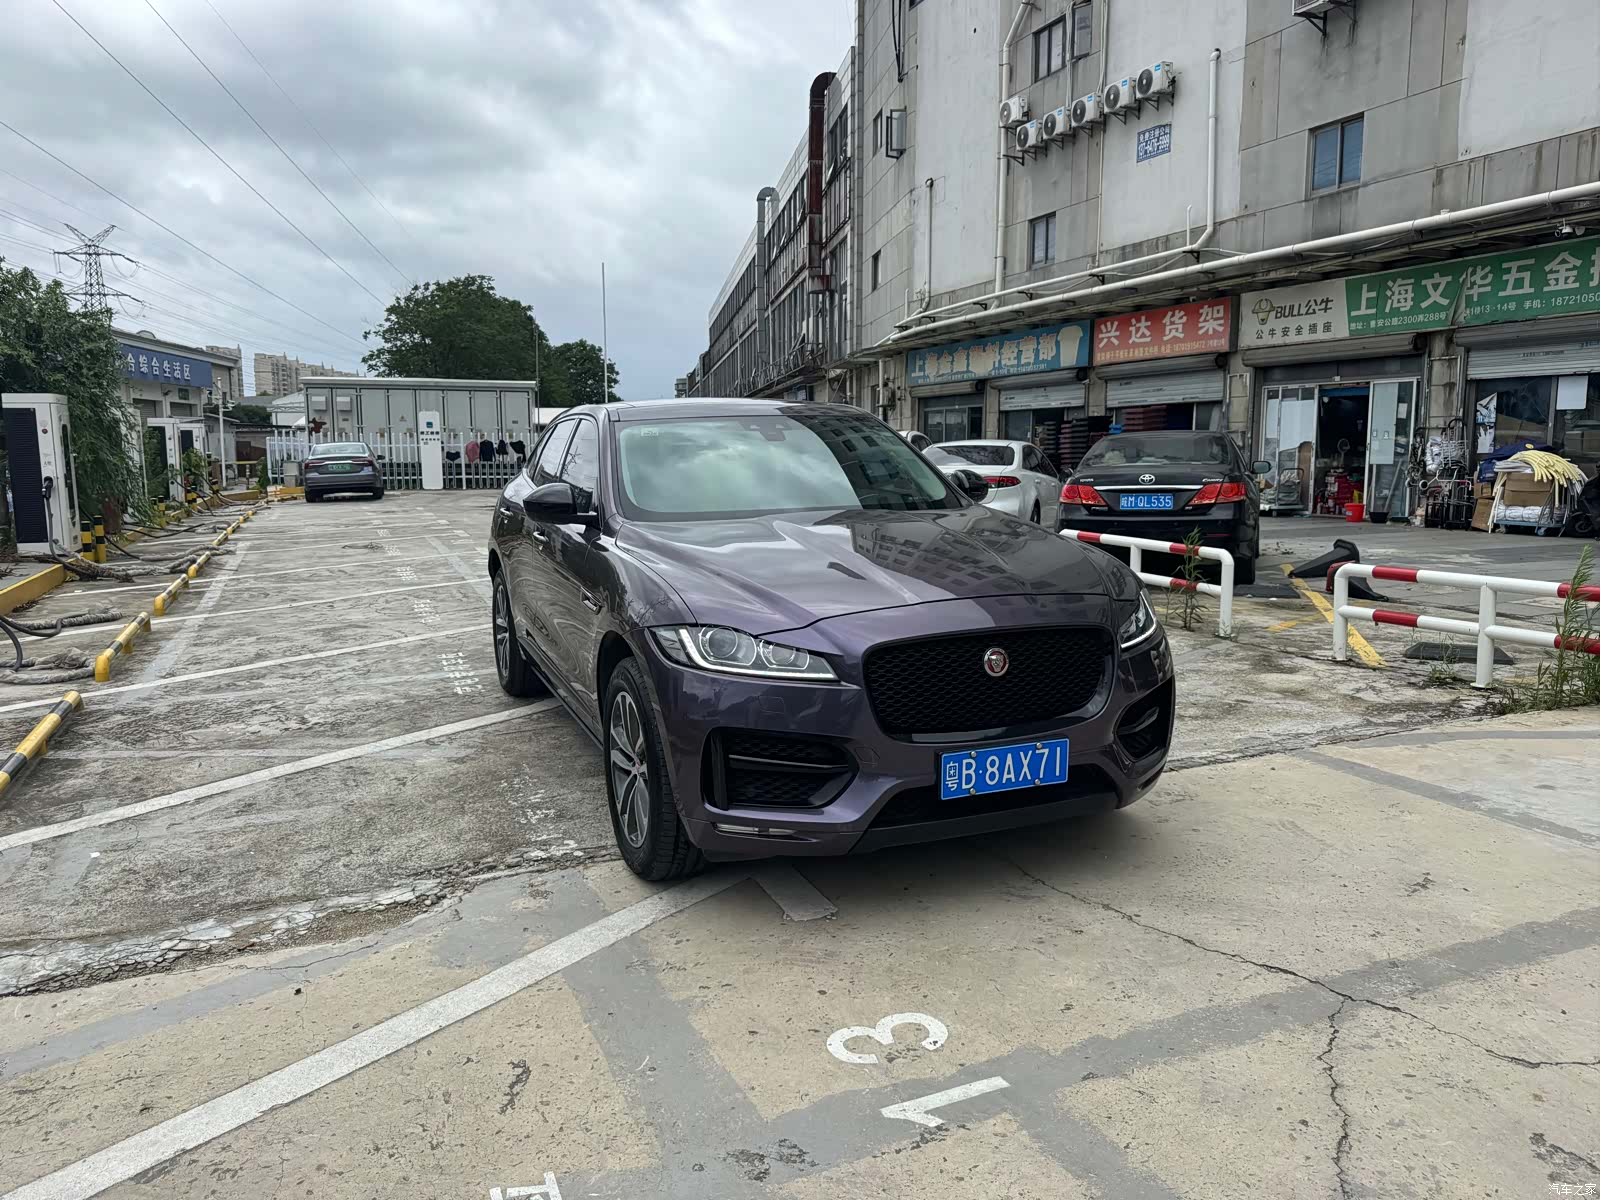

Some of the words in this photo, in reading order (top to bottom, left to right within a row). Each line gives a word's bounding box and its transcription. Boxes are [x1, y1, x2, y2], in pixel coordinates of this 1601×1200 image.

[1098, 305, 1225, 348] 兴达货架
[1256, 321, 1333, 339] 公牛安全插座
[945, 747, 1061, 791] 粤B·8AX71
